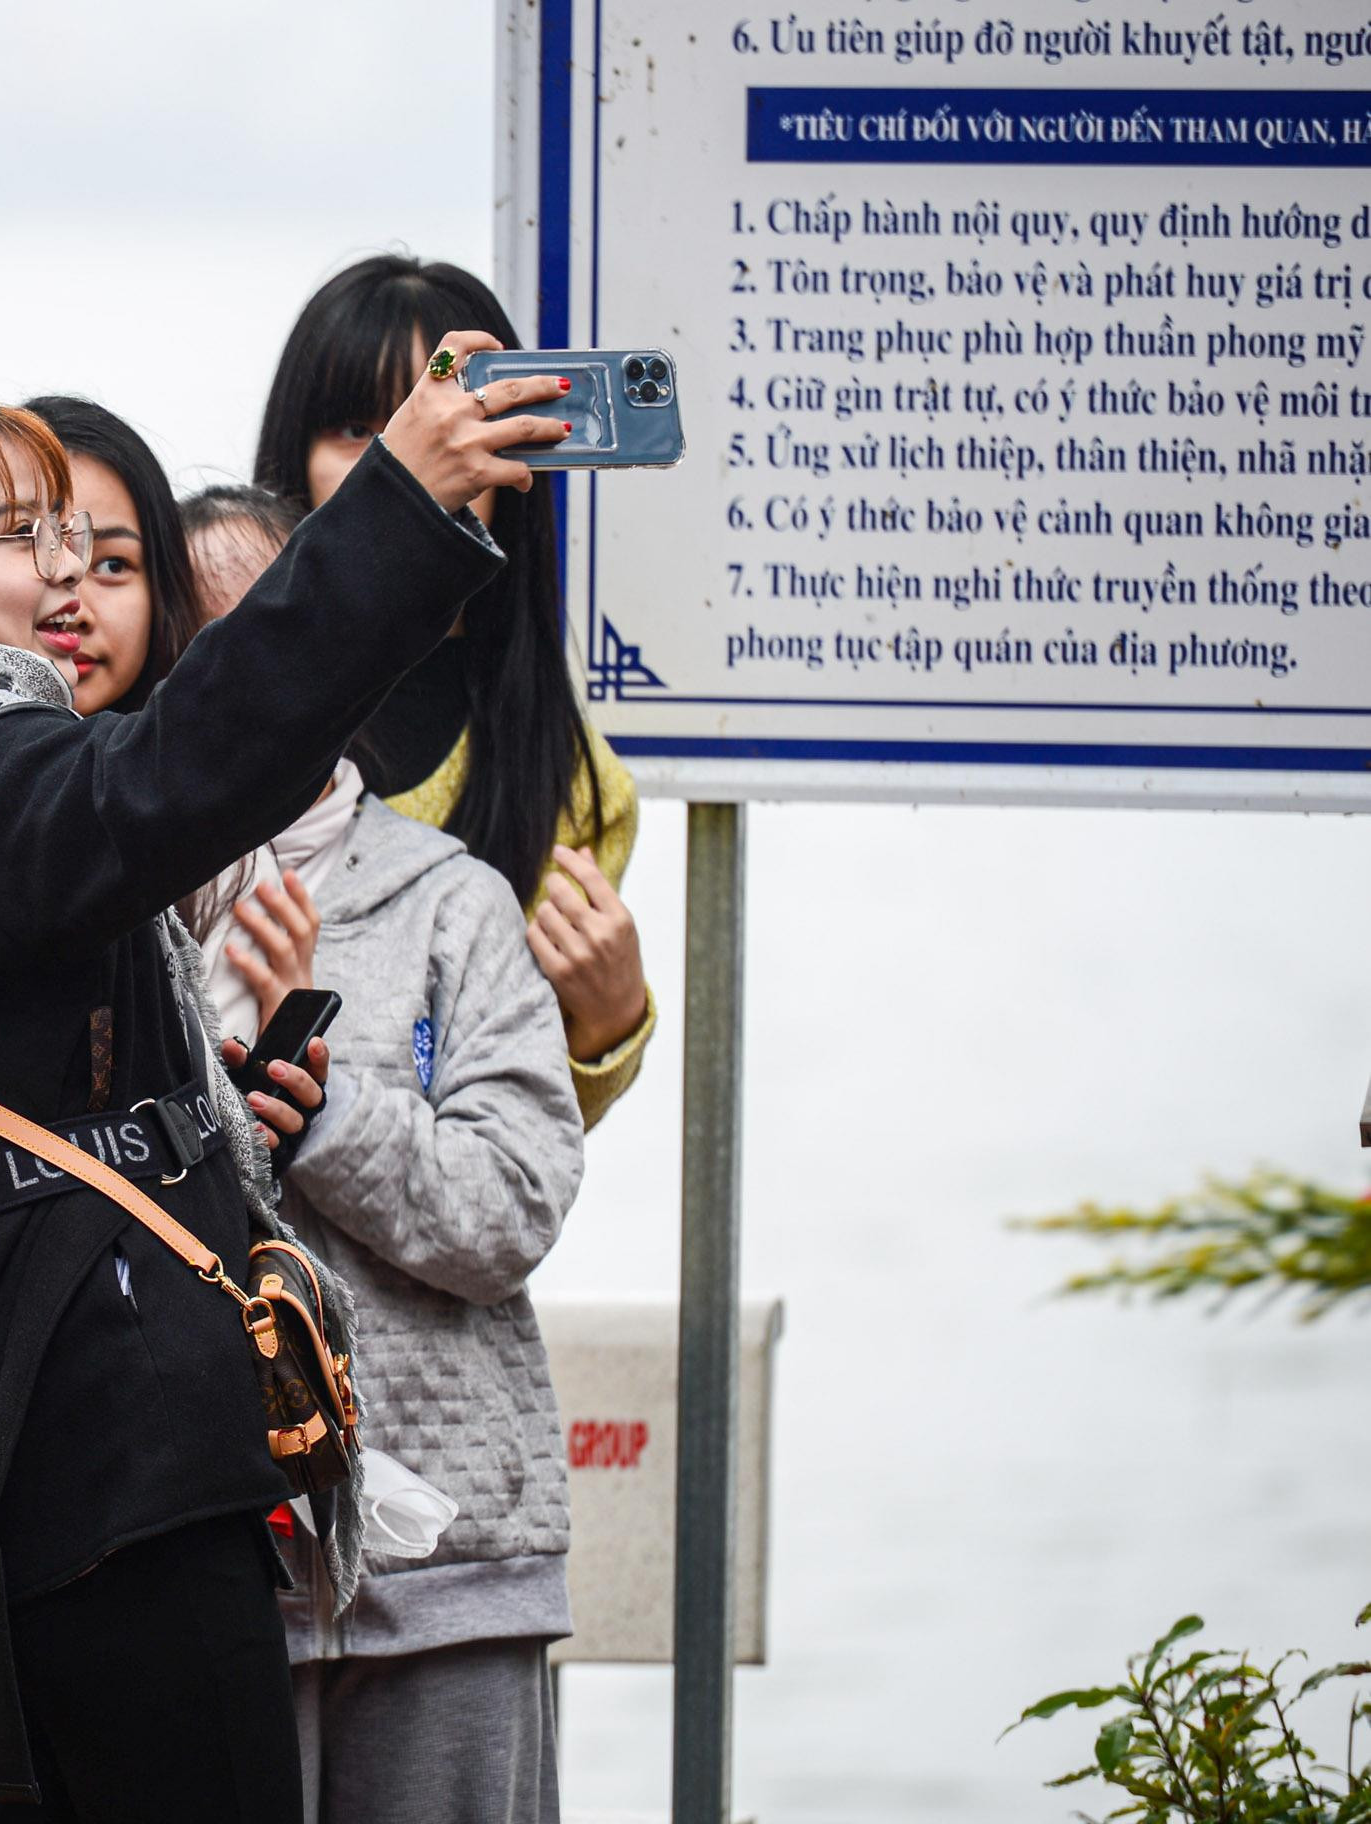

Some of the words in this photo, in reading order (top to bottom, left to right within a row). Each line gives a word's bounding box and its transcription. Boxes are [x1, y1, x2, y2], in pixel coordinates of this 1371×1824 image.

[732, 18, 759, 54] 6.
[770, 13, 815, 54] Ưu
[826, 18, 885, 54] tiên
[894, 19, 965, 65] giúp
[1024, 19, 1112, 65] người
[1122, 13, 1232, 66] khuyết
[1241, 19, 1295, 67] tật,
[858, 108, 907, 142] CHÍ
[1020, 109, 1104, 143] NGƯỜI
[1111, 106, 1163, 143] ĐẾN
[1170, 117, 1248, 143] THAM
[1254, 118, 1336, 149] QUAN,
[733, 201, 755, 233] 1.
[767, 193, 852, 244] Chấp
[863, 199, 941, 235] hành
[952, 200, 1000, 245] nội
[1010, 212, 1080, 246] quy,
[1089, 212, 1149, 247] quy
[1158, 202, 1231, 248] định
[732, 259, 756, 293] 2.
[768, 258, 829, 295] Tôn
[841, 266, 935, 304] trọng,
[946, 259, 1003, 296] bảo
[1013, 260, 1047, 306] vệ
[1058, 261, 1093, 297] và
[1104, 261, 1176, 307] phát
[1186, 262, 1246, 308] huy
[1255, 262, 1304, 309] giá
[1313, 263, 1352, 310] trị
[730, 318, 756, 352] 3.
[768, 317, 865, 362] Trang
[876, 319, 952, 363] phục
[963, 319, 1023, 364] phù
[1034, 321, 1094, 365] hợp
[1104, 313, 1196, 357] thuần
[1207, 322, 1307, 369] phong
[1316, 323, 1366, 369] mỹ
[729, 377, 755, 409] 4.
[766, 377, 826, 411] Giữ
[835, 377, 882, 419] gìn
[894, 377, 951, 421] trật
[963, 383, 1004, 421] tự,
[1014, 378, 1049, 414] có
[1058, 379, 1076, 421] ý
[1087, 379, 1157, 416] thức
[1168, 378, 1225, 417] bảo
[1235, 379, 1270, 426] vệ
[1279, 380, 1340, 418] môi
[728, 433, 754, 467] 5.
[841, 433, 880, 469] xử
[889, 435, 944, 478] lịch
[956, 435, 1045, 480] thiệp,
[1056, 436, 1126, 473] thân
[1138, 437, 1227, 482] thiện,
[1237, 439, 1297, 475] nhã
[1307, 439, 1371, 485] nhặ
[727, 495, 753, 530] 6.
[765, 496, 809, 531] Có
[817, 495, 835, 541] ý
[847, 498, 915, 532] thức
[927, 497, 983, 533] bảo
[994, 498, 1027, 543] vệ
[1037, 498, 1113, 535] cảnh
[1123, 511, 1204, 545] quan
[1214, 501, 1315, 548] không
[728, 563, 753, 596] 7.
[764, 563, 845, 608] Thực
[856, 565, 921, 608] hiện
[933, 567, 1001, 609] nghi
[1013, 567, 1082, 603] thức
[1092, 561, 1197, 613] truyền
[1208, 562, 1299, 616] thống
[727, 626, 824, 668] phong
[835, 628, 882, 670] tục
[892, 627, 943, 671] tập
[953, 629, 1033, 673] quán
[1043, 628, 1098, 665] của
[1108, 630, 1157, 675] địa
[1169, 632, 1298, 678] phương.
[568, 1420, 648, 1469] GROUP
